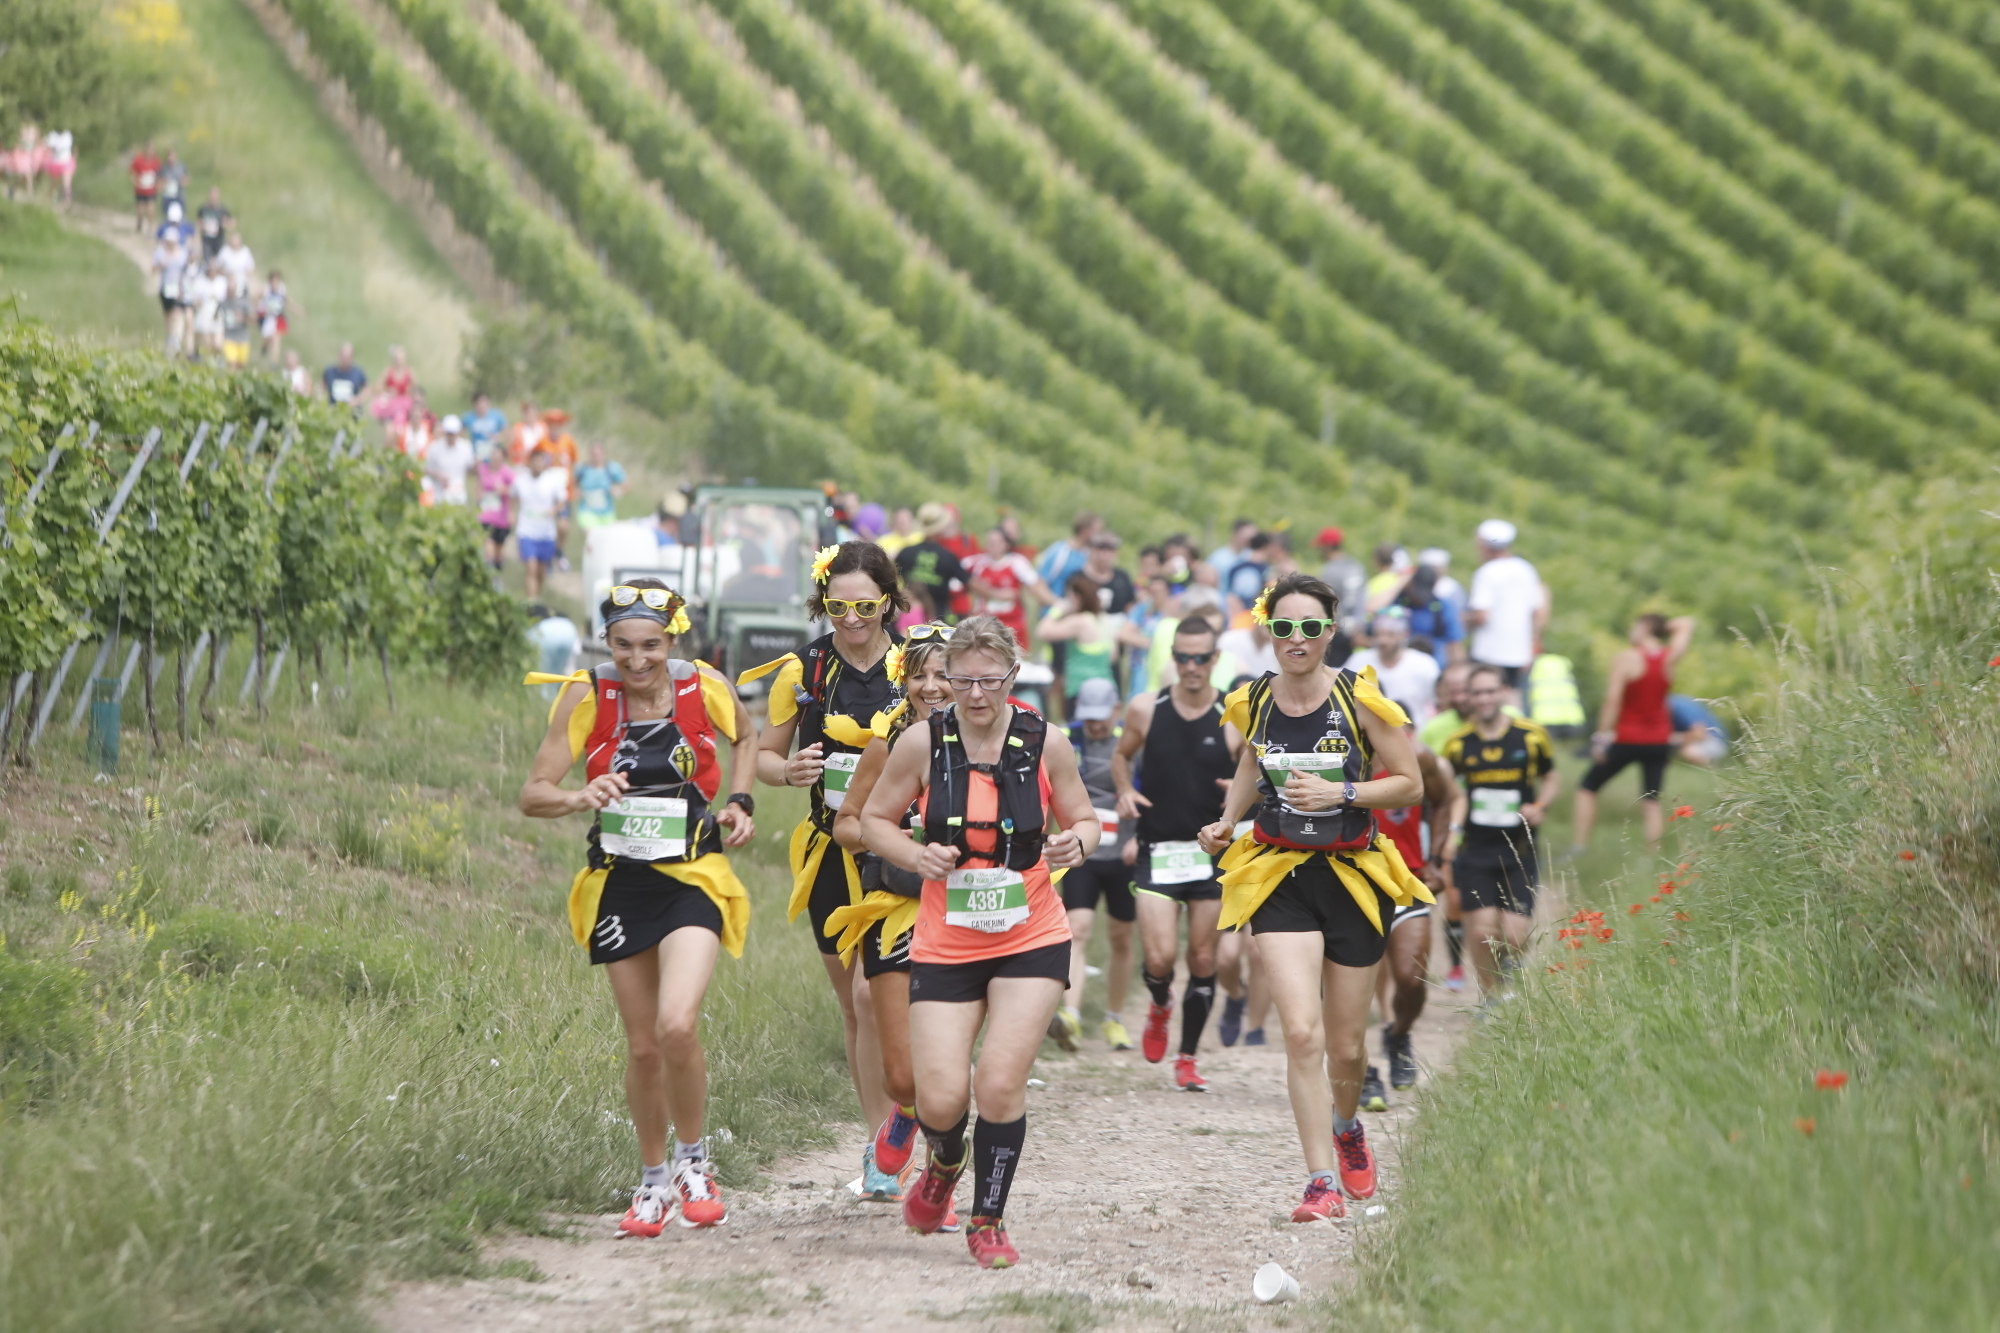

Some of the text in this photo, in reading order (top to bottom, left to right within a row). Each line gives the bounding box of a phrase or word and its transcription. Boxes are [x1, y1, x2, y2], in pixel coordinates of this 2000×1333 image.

[620, 817, 663, 838] 4242
[967, 888, 1006, 911] 4387
[971, 919, 1007, 929] CATHERINE
